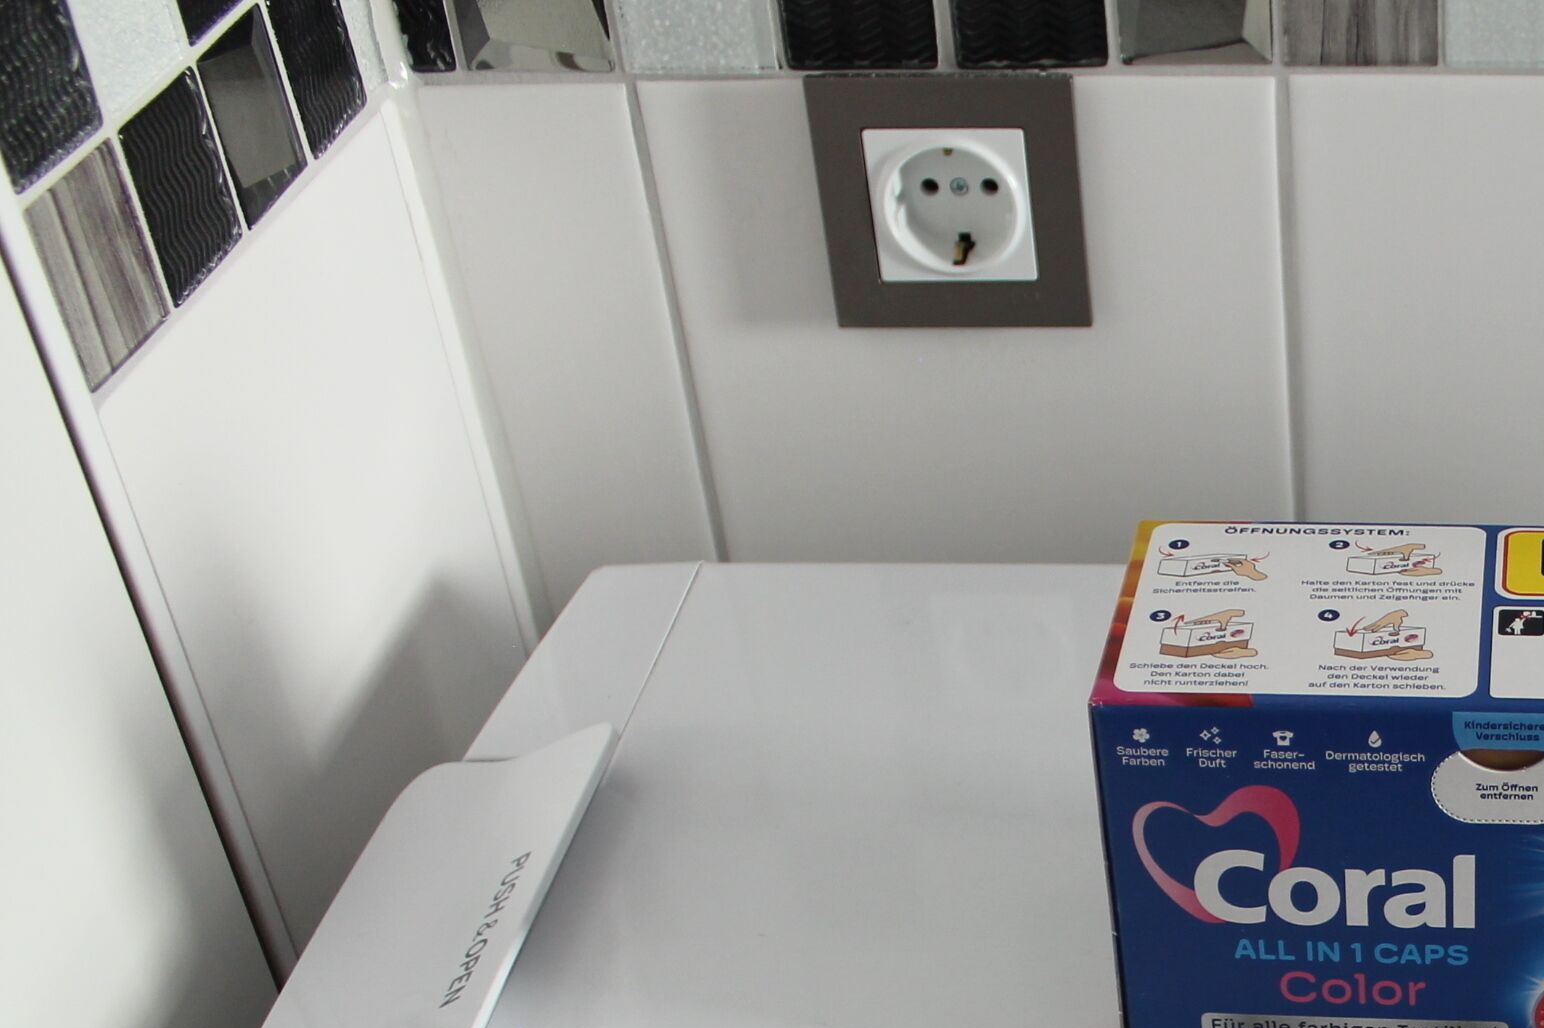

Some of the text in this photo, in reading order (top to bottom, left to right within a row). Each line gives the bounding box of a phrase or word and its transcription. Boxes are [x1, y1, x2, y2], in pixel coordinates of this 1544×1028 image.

[1225, 526, 1410, 536] ÖFFNUNGSSYSTEM:
[1371, 665, 1439, 673] Verwendung
[1476, 732, 1540, 741] Verschluss
[1116, 746, 1169, 756] Saubere
[1186, 747, 1238, 758] Frischer
[1263, 749, 1305, 760] Faser-
[1325, 750, 1425, 763] Dermatologisch
[1122, 756, 1165, 766] Farben
[1199, 758, 1226, 768] Duft
[1254, 759, 1316, 770] schonend
[1349, 762, 1403, 773] getestet
[1475, 782, 1538, 792] Zum Öffnen
[1480, 792, 1534, 800] entfernen
[1194, 849, 1476, 929] Coral
[439, 851, 532, 1009] PUSH & OPEN
[1235, 939, 1468, 965] ALL IN 1 CAPS
[1280, 971, 1427, 1006] Color
